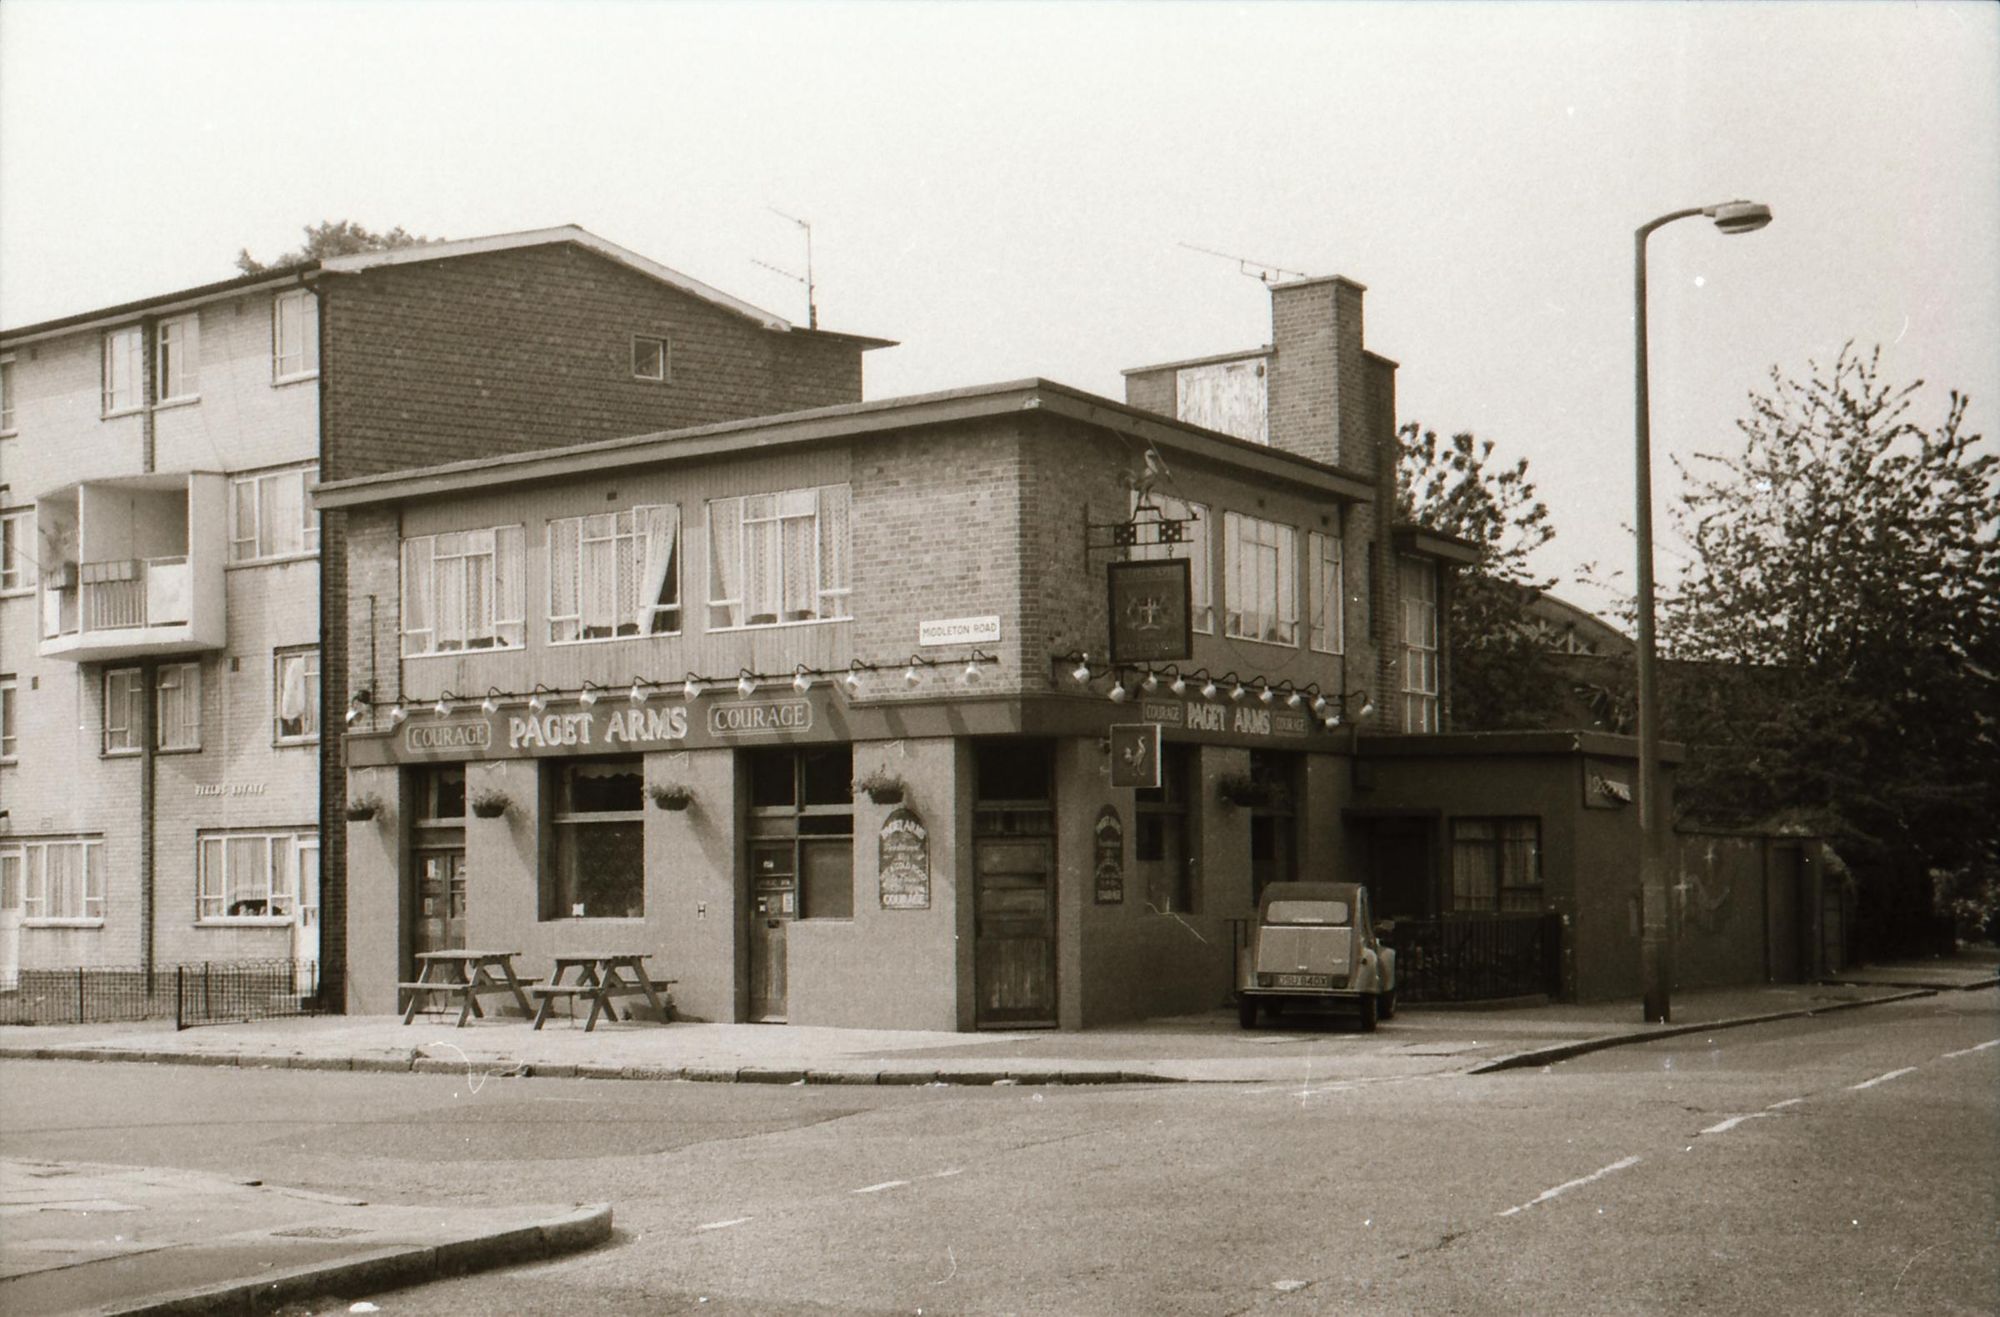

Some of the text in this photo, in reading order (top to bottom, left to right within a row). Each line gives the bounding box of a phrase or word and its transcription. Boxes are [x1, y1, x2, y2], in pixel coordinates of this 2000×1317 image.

[922, 622, 997, 638] MIDDLETON ROAD
[714, 703, 804, 731] COURAGE
[1146, 703, 1180, 721] COURAGE
[1187, 702, 1271, 735] PAGET ARMS
[412, 725, 486, 748] COURAGE
[508, 706, 689, 749] PAGET ARMS
[883, 893, 925, 906] COURAGE
